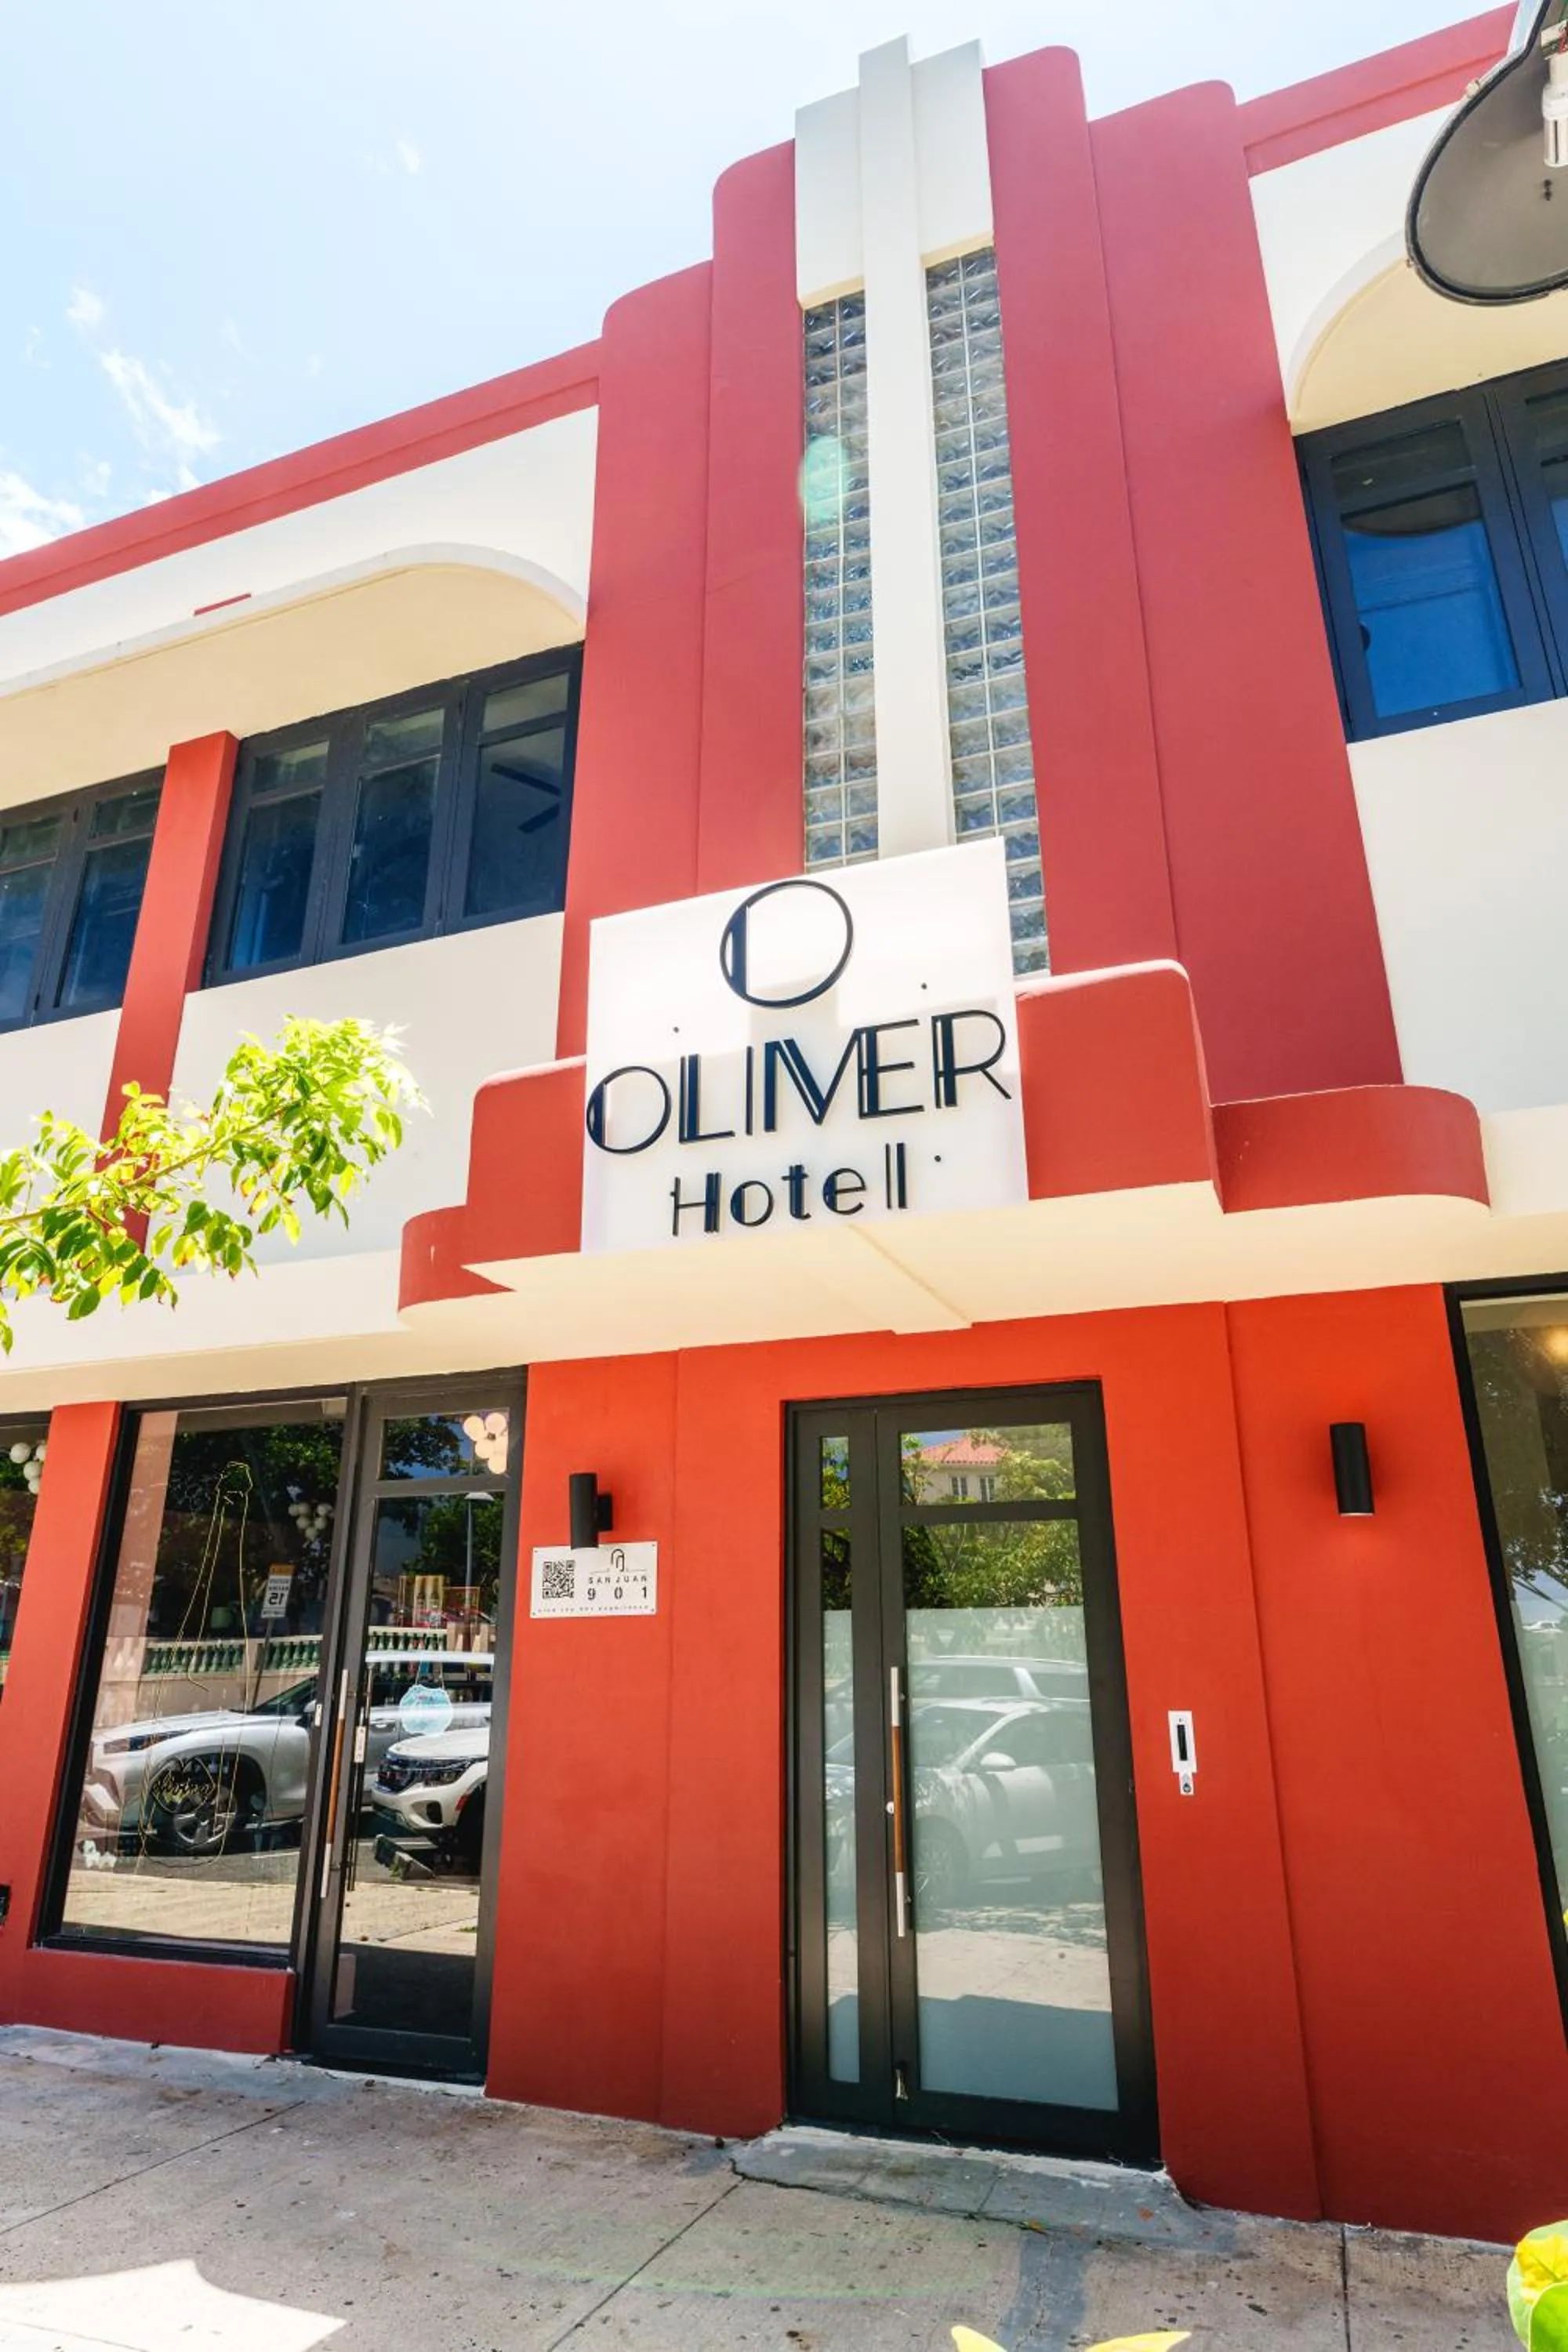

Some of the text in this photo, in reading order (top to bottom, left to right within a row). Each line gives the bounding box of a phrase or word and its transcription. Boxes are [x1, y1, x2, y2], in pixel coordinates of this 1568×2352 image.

[720, 879, 854, 1009] O
[586, 1009, 1012, 1154] OLIVER
[670, 1142, 907, 1236] Hotel
[615, 1575, 647, 1584] JUAN
